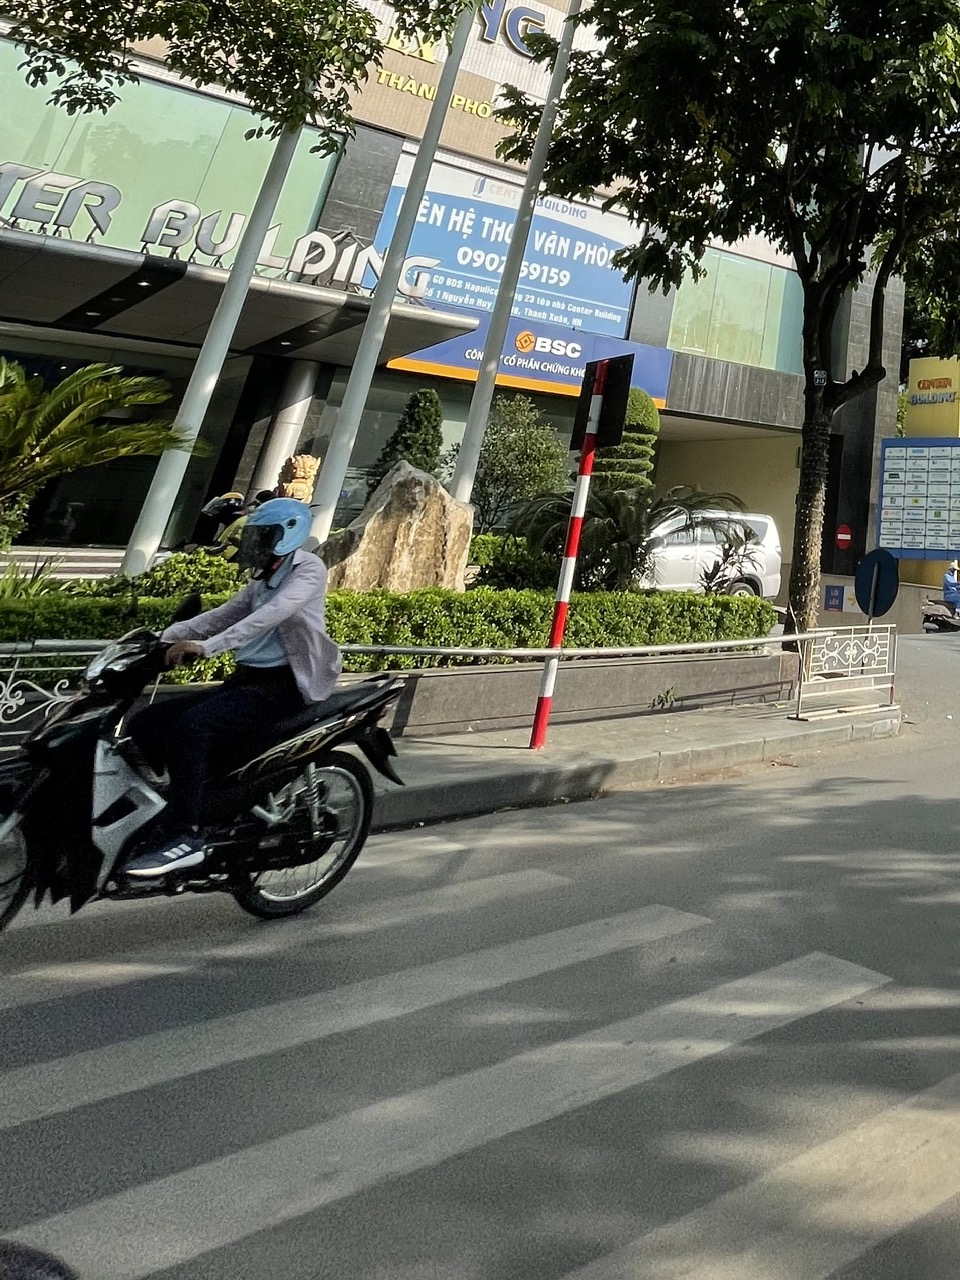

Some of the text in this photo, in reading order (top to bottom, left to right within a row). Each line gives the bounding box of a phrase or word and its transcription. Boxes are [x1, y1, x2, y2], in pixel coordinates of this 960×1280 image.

[377, 67, 437, 101] THÀN
[447, 207, 476, 239] HỆ
[534, 230, 570, 258] VĂN
[140, 199, 443, 299] BULDING
[476, 298, 493, 310] Huy
[524, 294, 535, 303] 23
[567, 304, 593, 317] Center
[594, 308, 622, 323] Building
[534, 336, 582, 359] BSC
